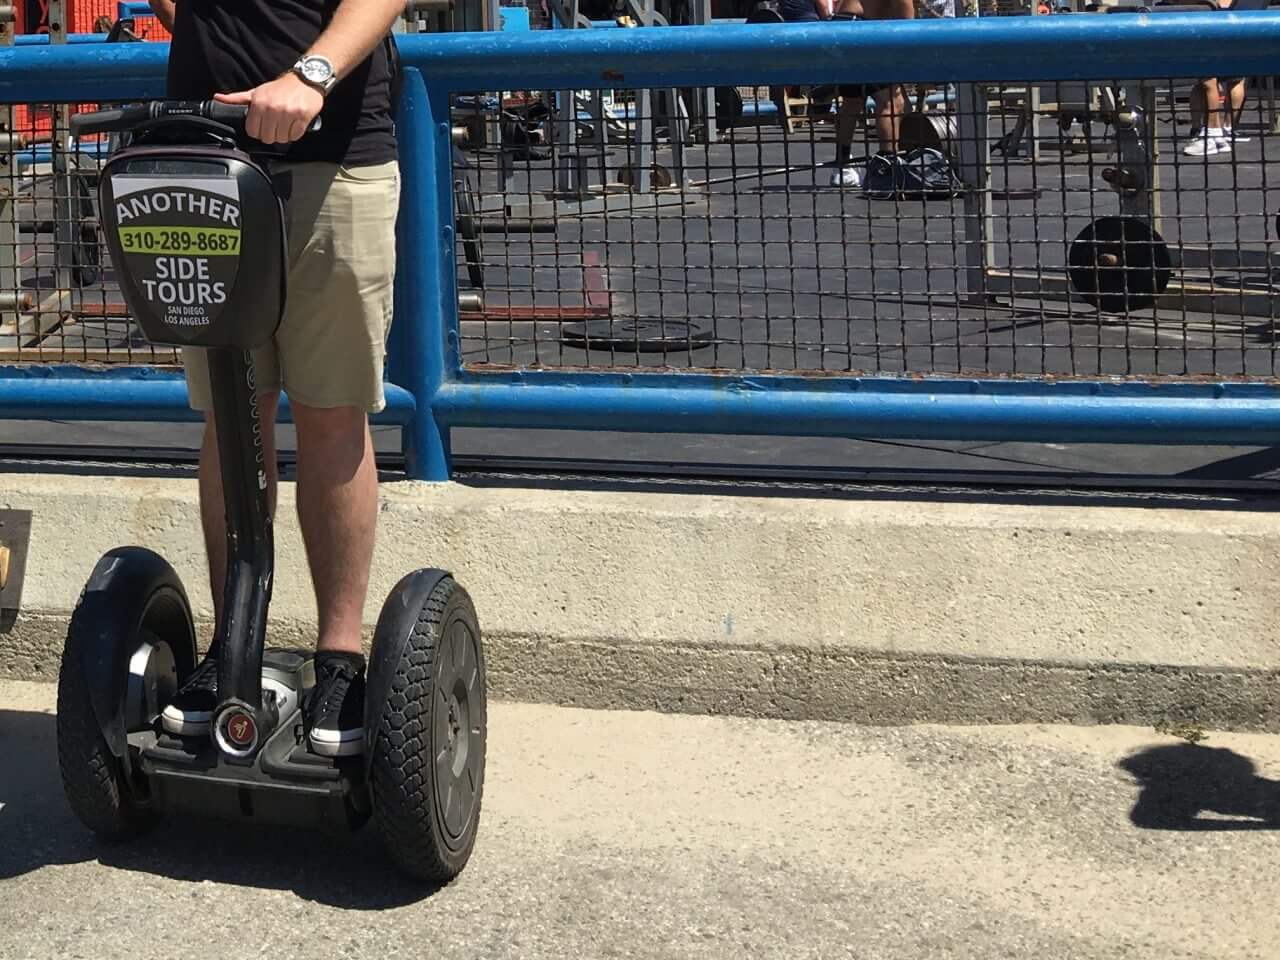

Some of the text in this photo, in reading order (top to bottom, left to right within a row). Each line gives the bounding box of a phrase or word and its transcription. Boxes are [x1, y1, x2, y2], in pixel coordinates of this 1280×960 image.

[116, 192, 240, 226] ANOTHER
[123, 231, 239, 251] 310-289-8687
[155, 257, 210, 280] SIDE
[142, 279, 226, 305] TOURS
[164, 316, 210, 325] LOS ANGELES
[168, 306, 205, 315] SAN DIEGO
